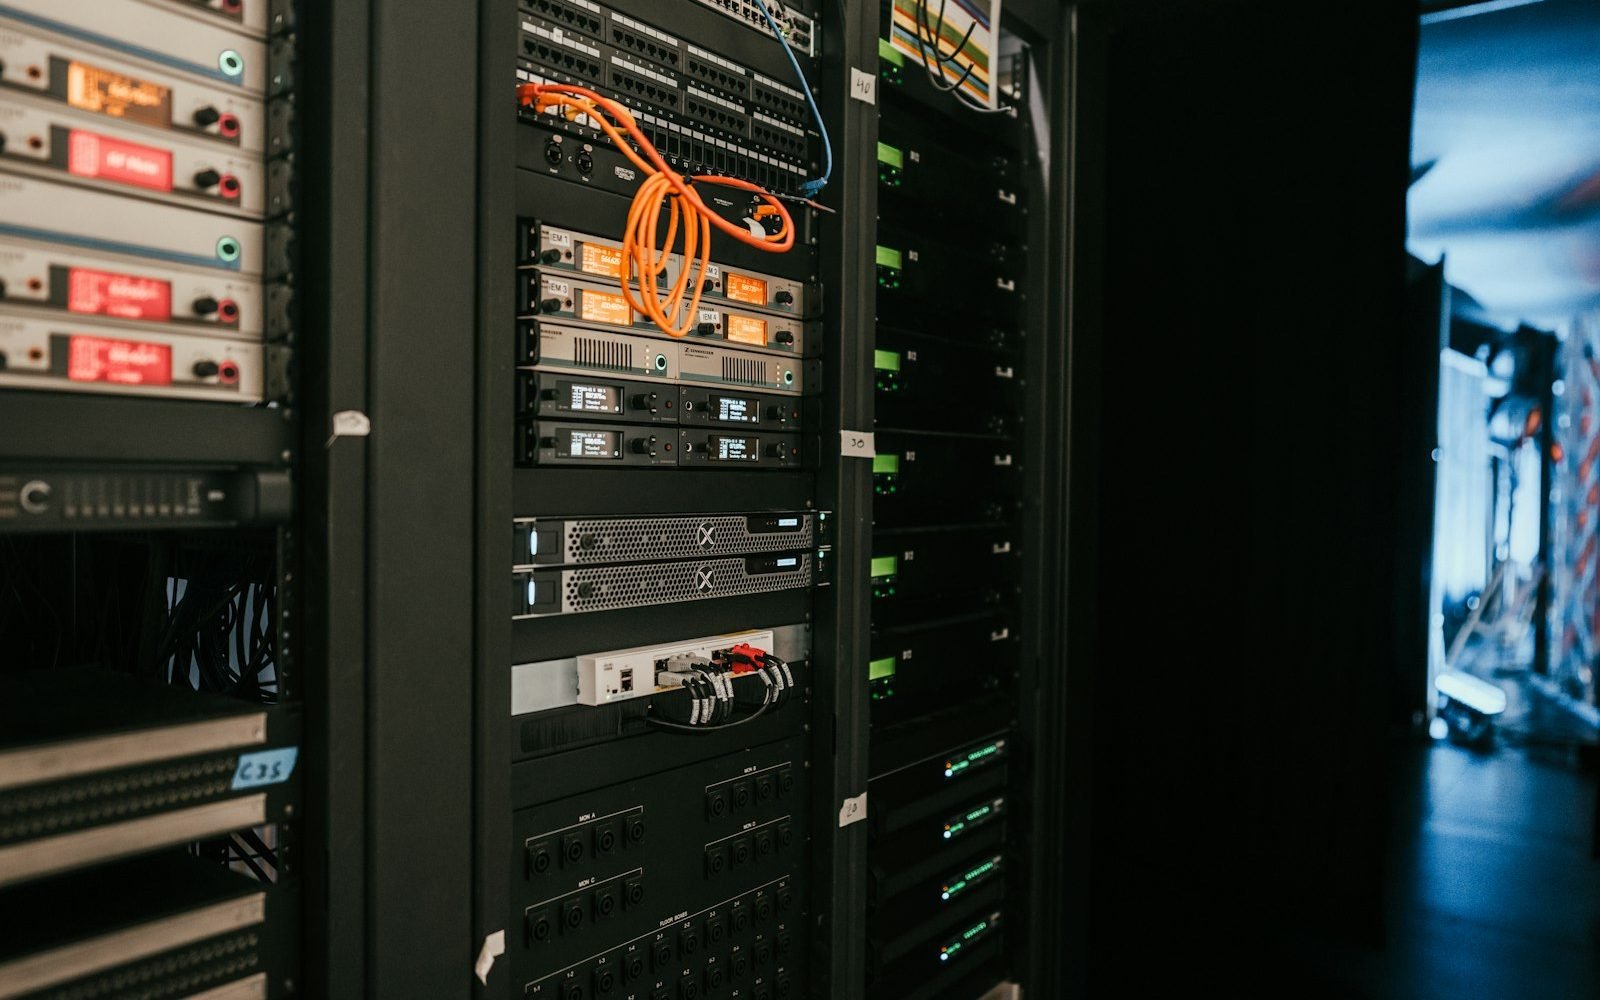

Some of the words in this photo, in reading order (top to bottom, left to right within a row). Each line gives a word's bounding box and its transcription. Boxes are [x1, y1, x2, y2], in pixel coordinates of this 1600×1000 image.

[856, 78, 870, 94] 40
[851, 438, 864, 448] 30
[579, 814, 590, 822] MON
[578, 879, 589, 887] MON
[660, 917, 674, 927] FLOOR
